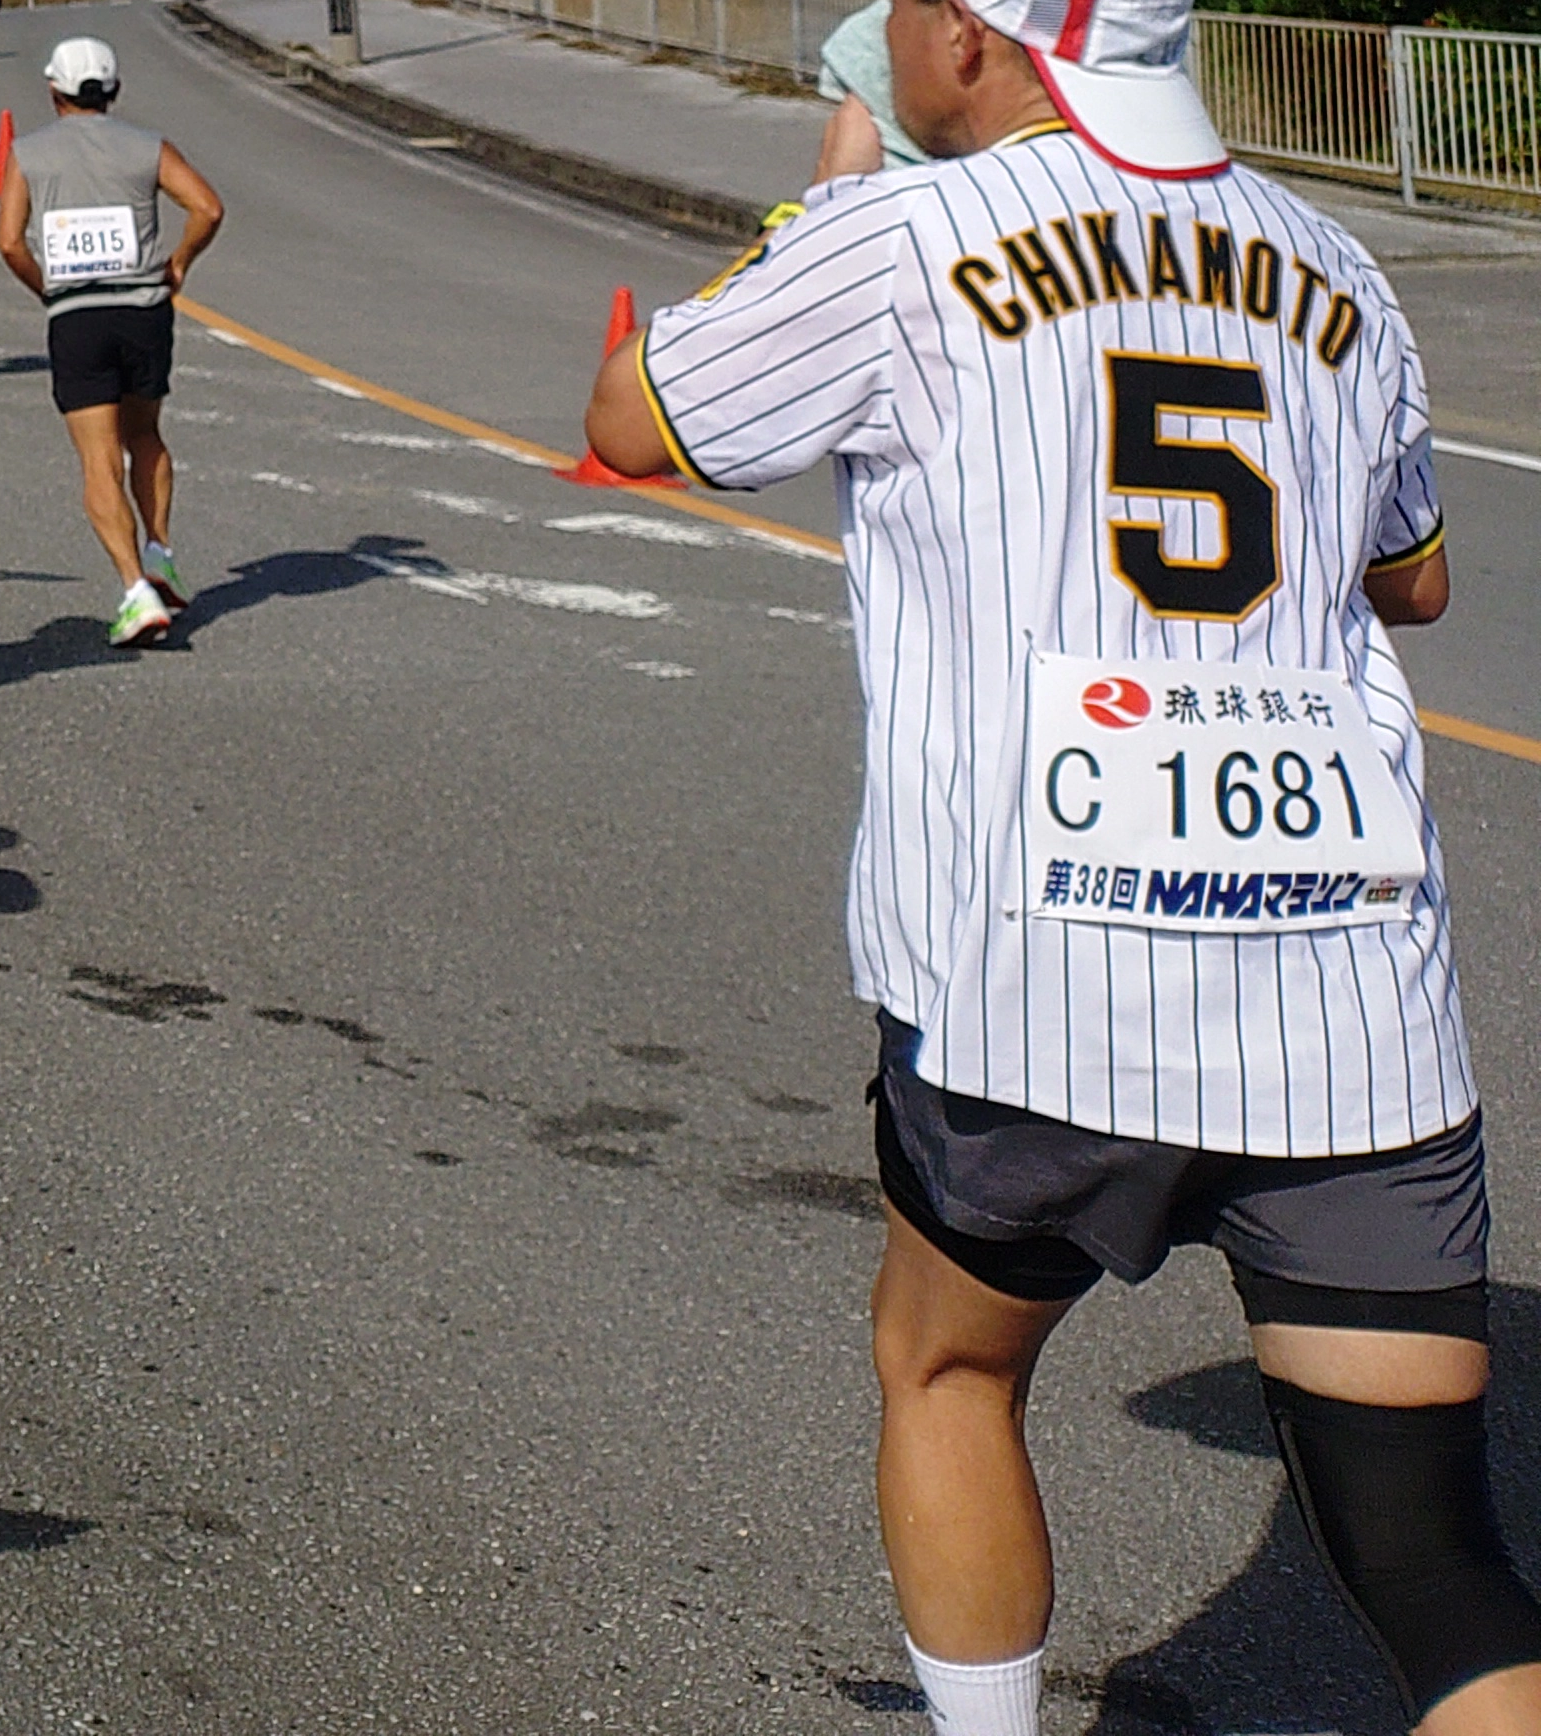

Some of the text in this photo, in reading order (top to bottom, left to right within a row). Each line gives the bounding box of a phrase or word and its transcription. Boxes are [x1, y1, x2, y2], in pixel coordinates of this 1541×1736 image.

[47, 228, 124, 259] E 4815
[948, 211, 1363, 373] CHIKAMOTO
[1102, 349, 1284, 624] 5
[1164, 684, 1335, 729] 琉球銀行
[1045, 746, 1366, 840] C 1681
[1042, 856, 1369, 920] 第38回 NAHAマラソン
